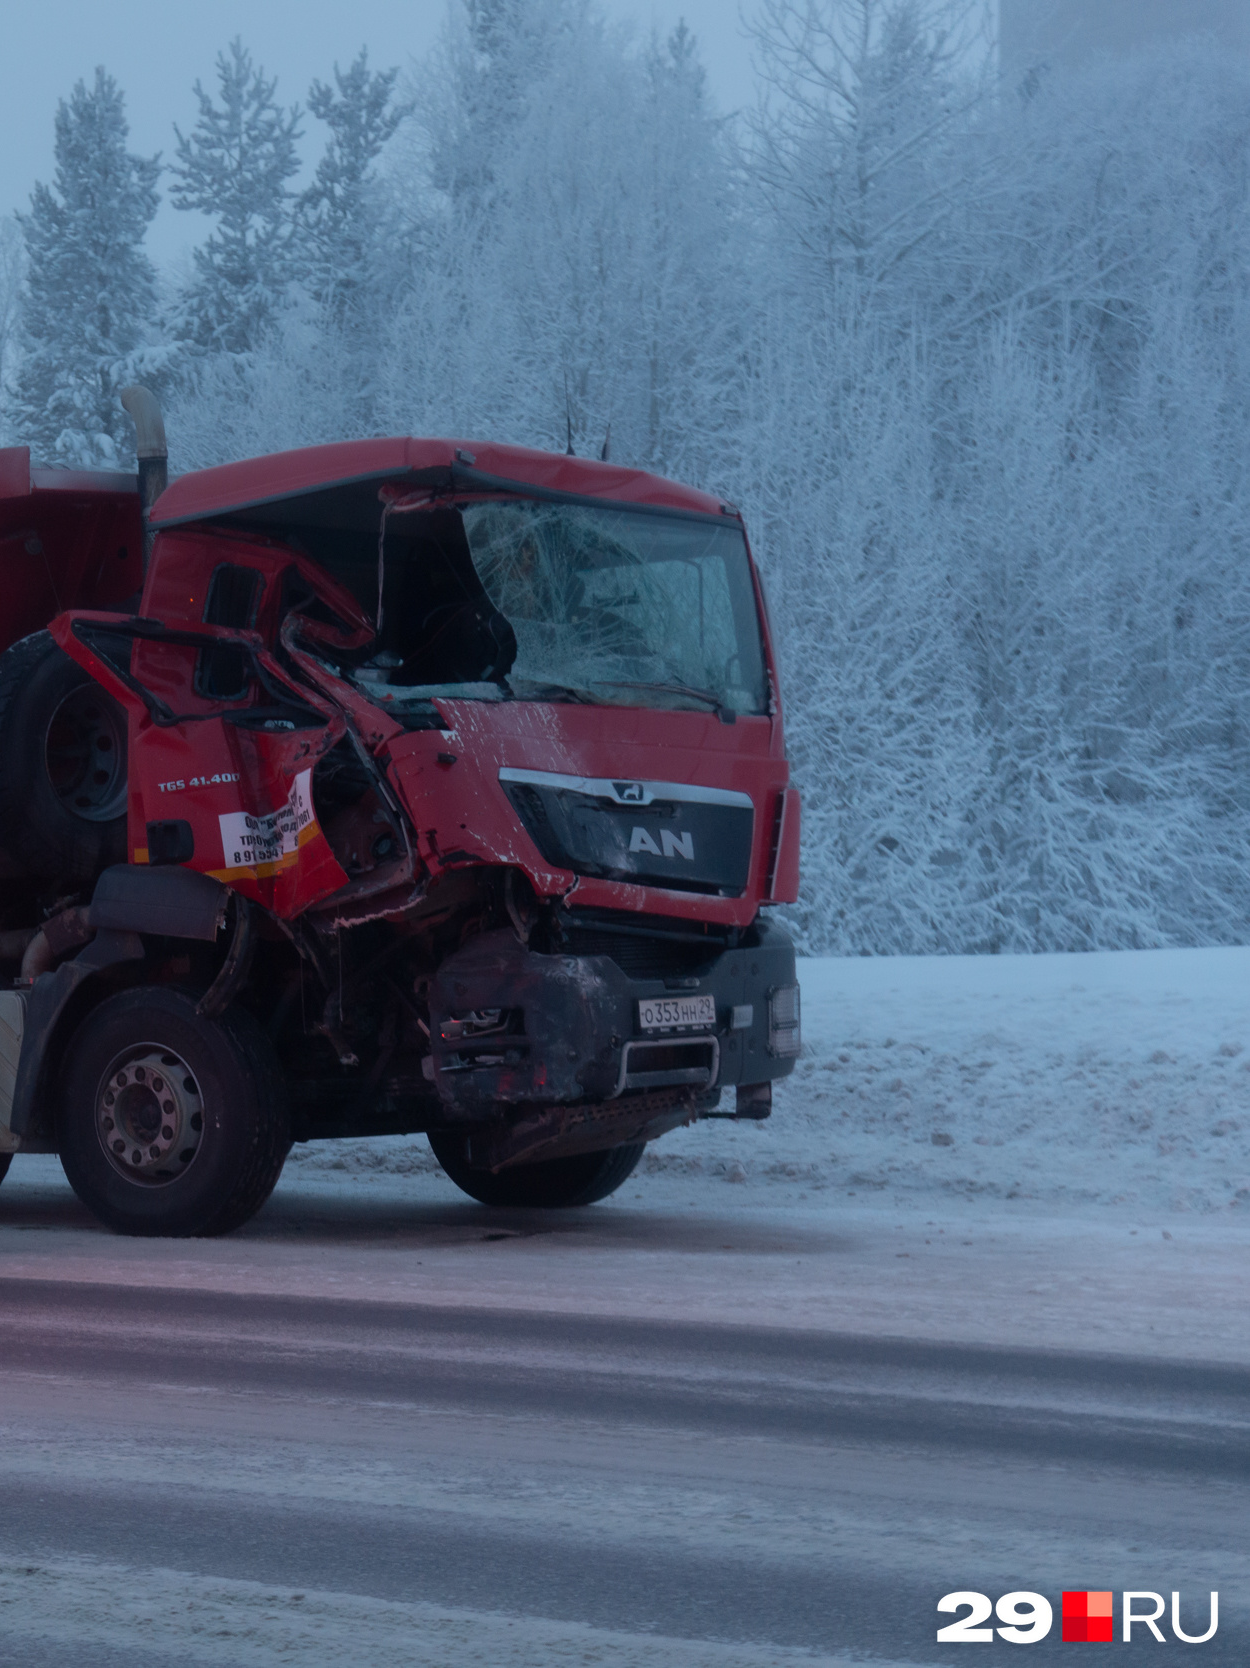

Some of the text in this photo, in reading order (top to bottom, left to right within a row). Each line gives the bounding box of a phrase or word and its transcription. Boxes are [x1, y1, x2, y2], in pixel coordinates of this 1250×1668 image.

[157, 772, 241, 793] TGS 41.400
[234, 851, 241, 863] 8
[699, 998, 711, 1014] 29
